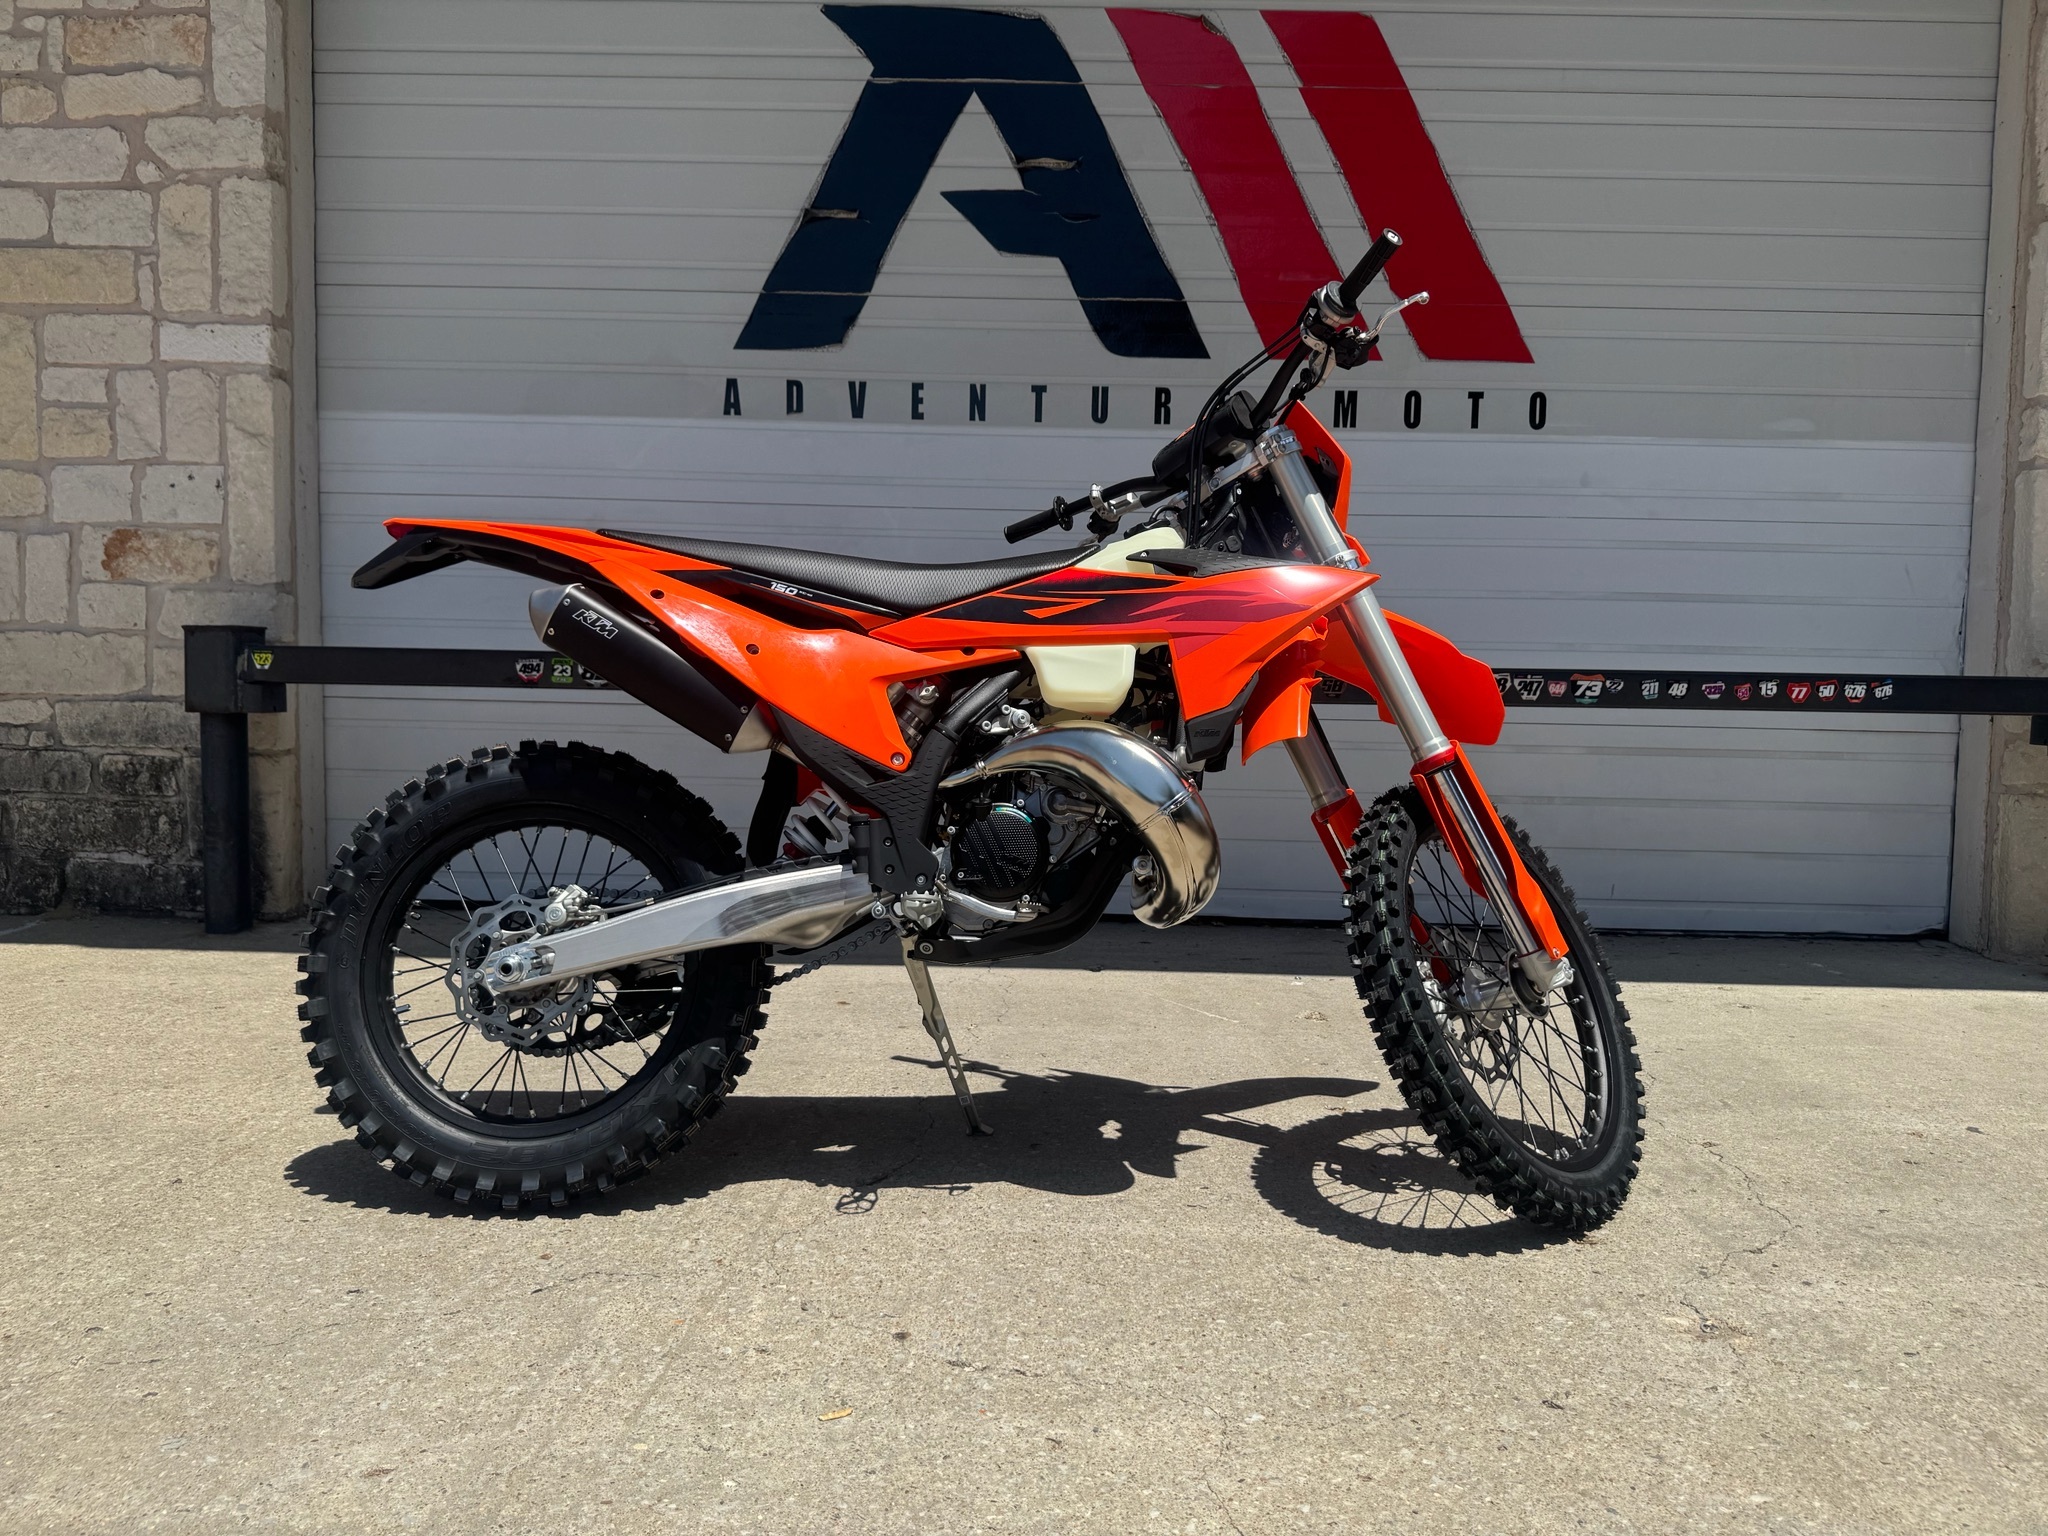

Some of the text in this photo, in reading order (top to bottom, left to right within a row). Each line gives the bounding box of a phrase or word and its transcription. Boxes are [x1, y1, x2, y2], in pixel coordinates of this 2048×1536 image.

[724, 378, 1548, 430] ADVENTUR MOTO
[770, 581, 799, 596] 150
[572, 608, 619, 640] KTM
[518, 662, 541, 674] 494
[552, 665, 572, 677] 23
[1574, 680, 1603, 697] 73
[1641, 682, 1659, 696] 211
[1667, 683, 1689, 696] 48
[1759, 681, 1778, 697] 15
[1791, 687, 1807, 699] 77
[1818, 684, 1835, 697] 50
[338, 801, 454, 950] DUNLOP
